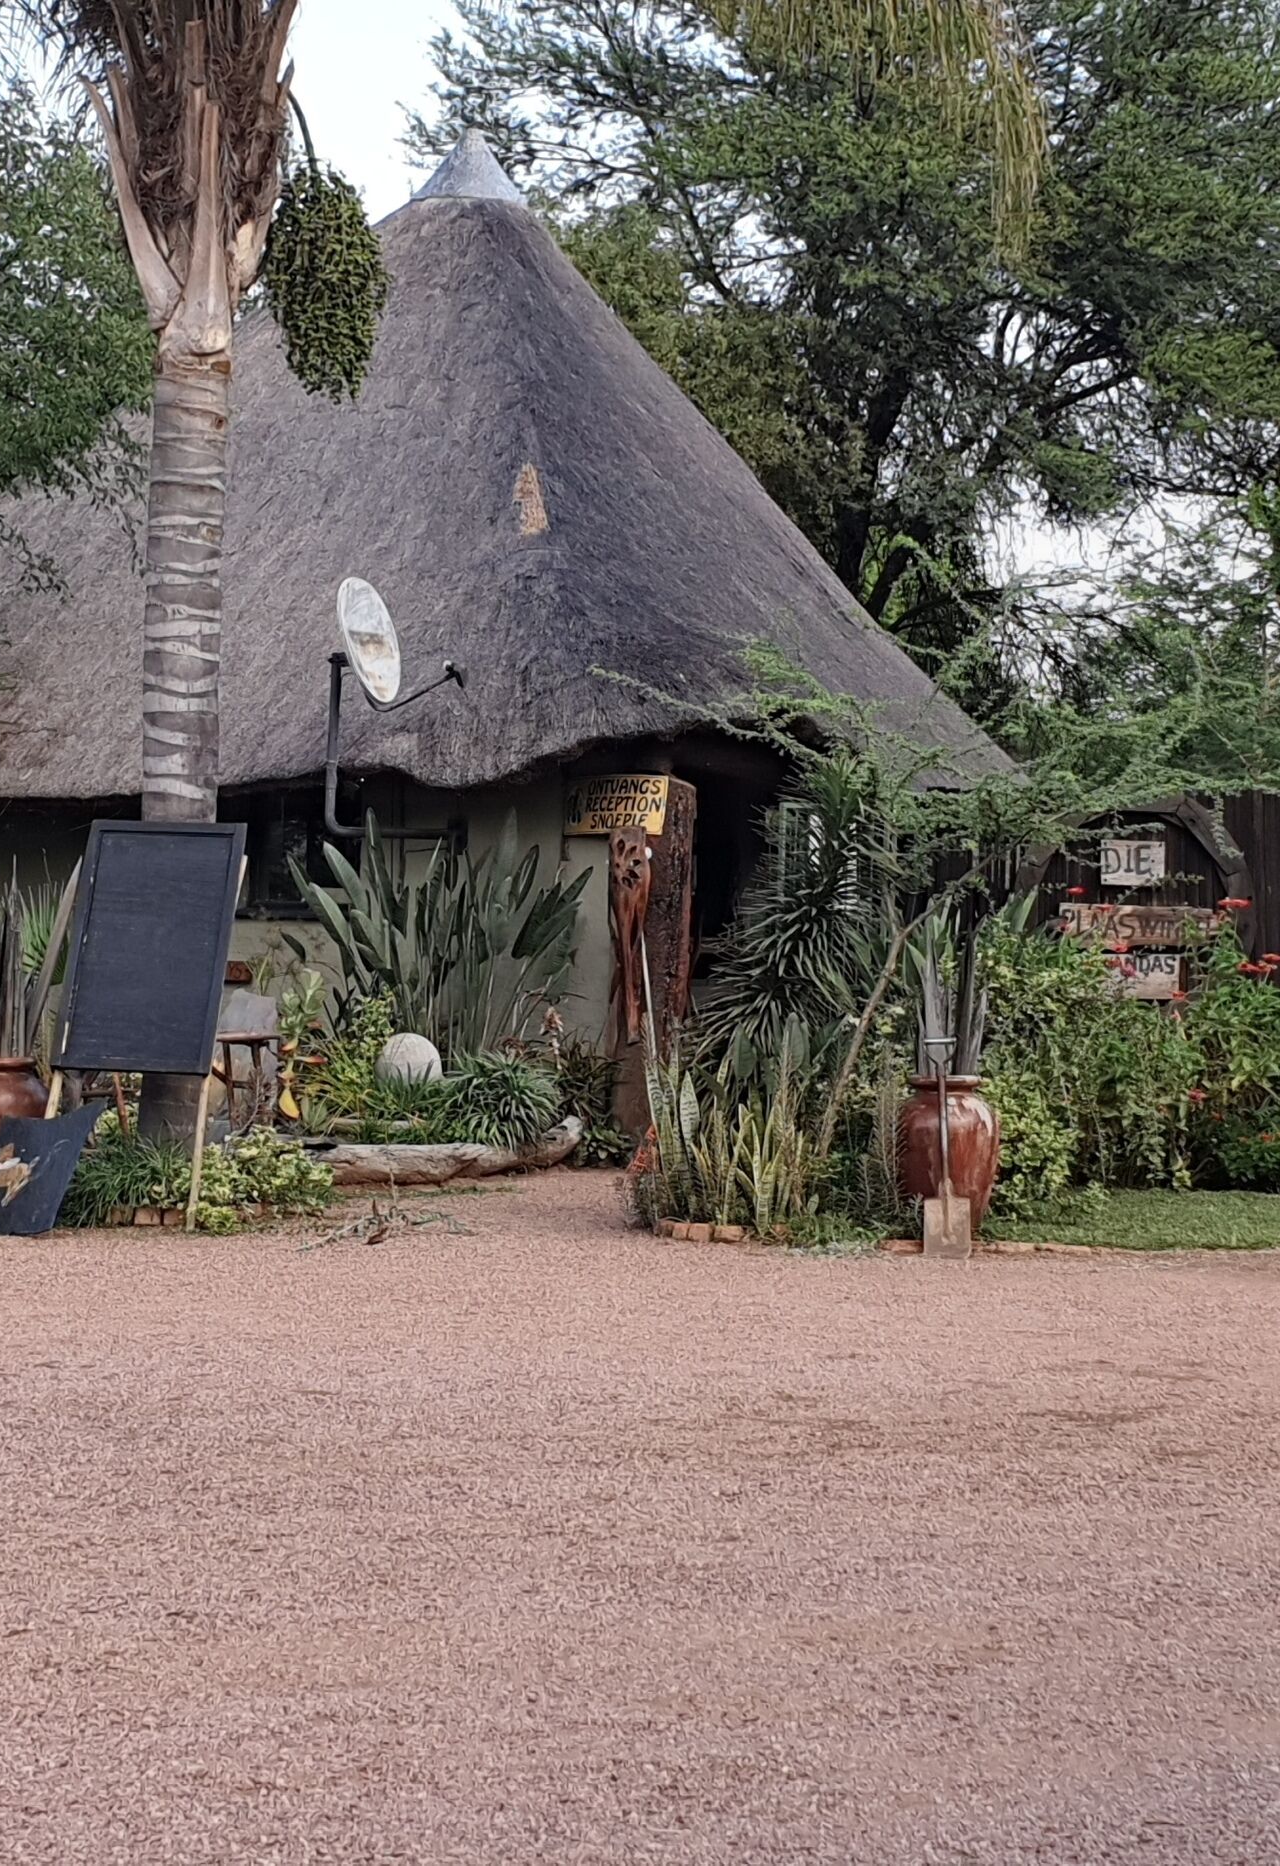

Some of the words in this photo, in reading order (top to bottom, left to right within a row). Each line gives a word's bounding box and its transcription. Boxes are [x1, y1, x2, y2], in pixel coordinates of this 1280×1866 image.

[588, 779, 661, 795] ONTVANGS
[585, 796, 661, 812] RECEPTION
[1103, 845, 1152, 875] DIE
